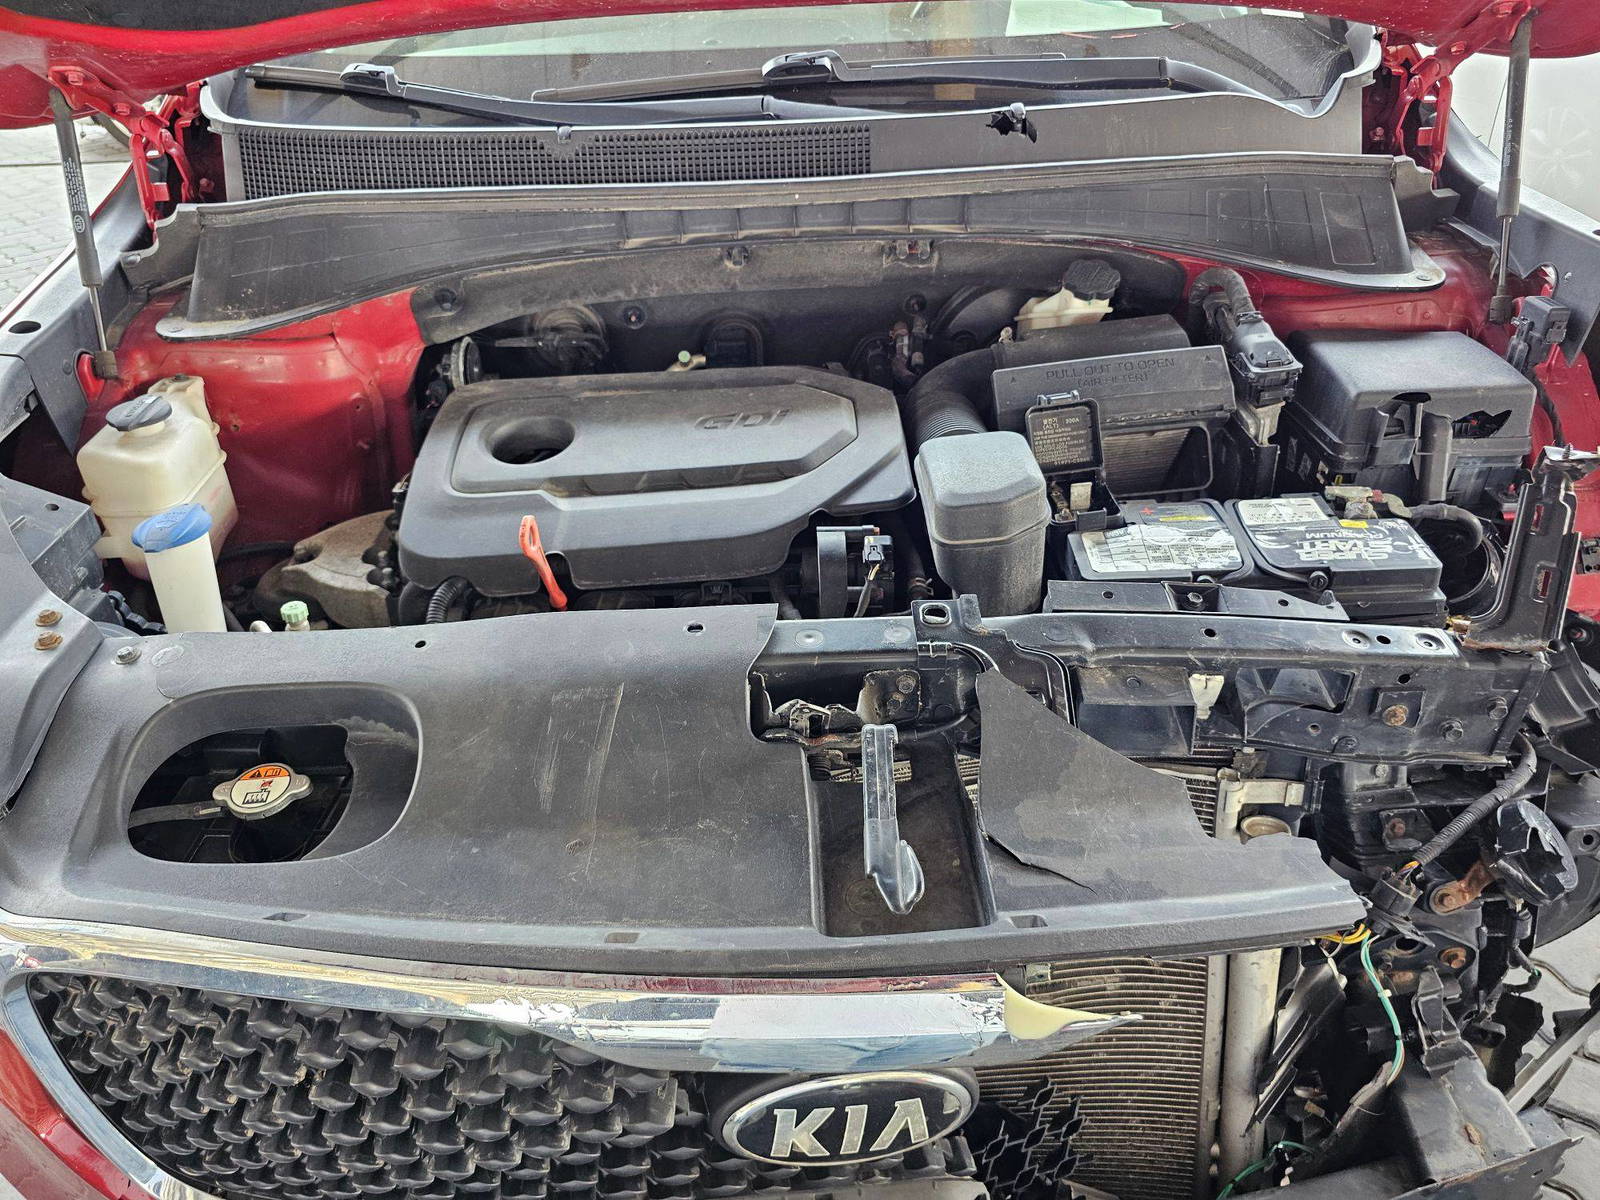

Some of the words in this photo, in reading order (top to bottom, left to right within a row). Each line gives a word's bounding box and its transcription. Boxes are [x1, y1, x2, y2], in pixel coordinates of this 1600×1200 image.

[1046, 369, 1082, 380] PULL
[1084, 364, 1111, 376] OUT
[1117, 361, 1134, 371] TO
[1137, 358, 1176, 370] OPEN
[1298, 540, 1393, 553] START
[1298, 549, 1389, 561] SUPER
[770, 1097, 929, 1157] KIA
